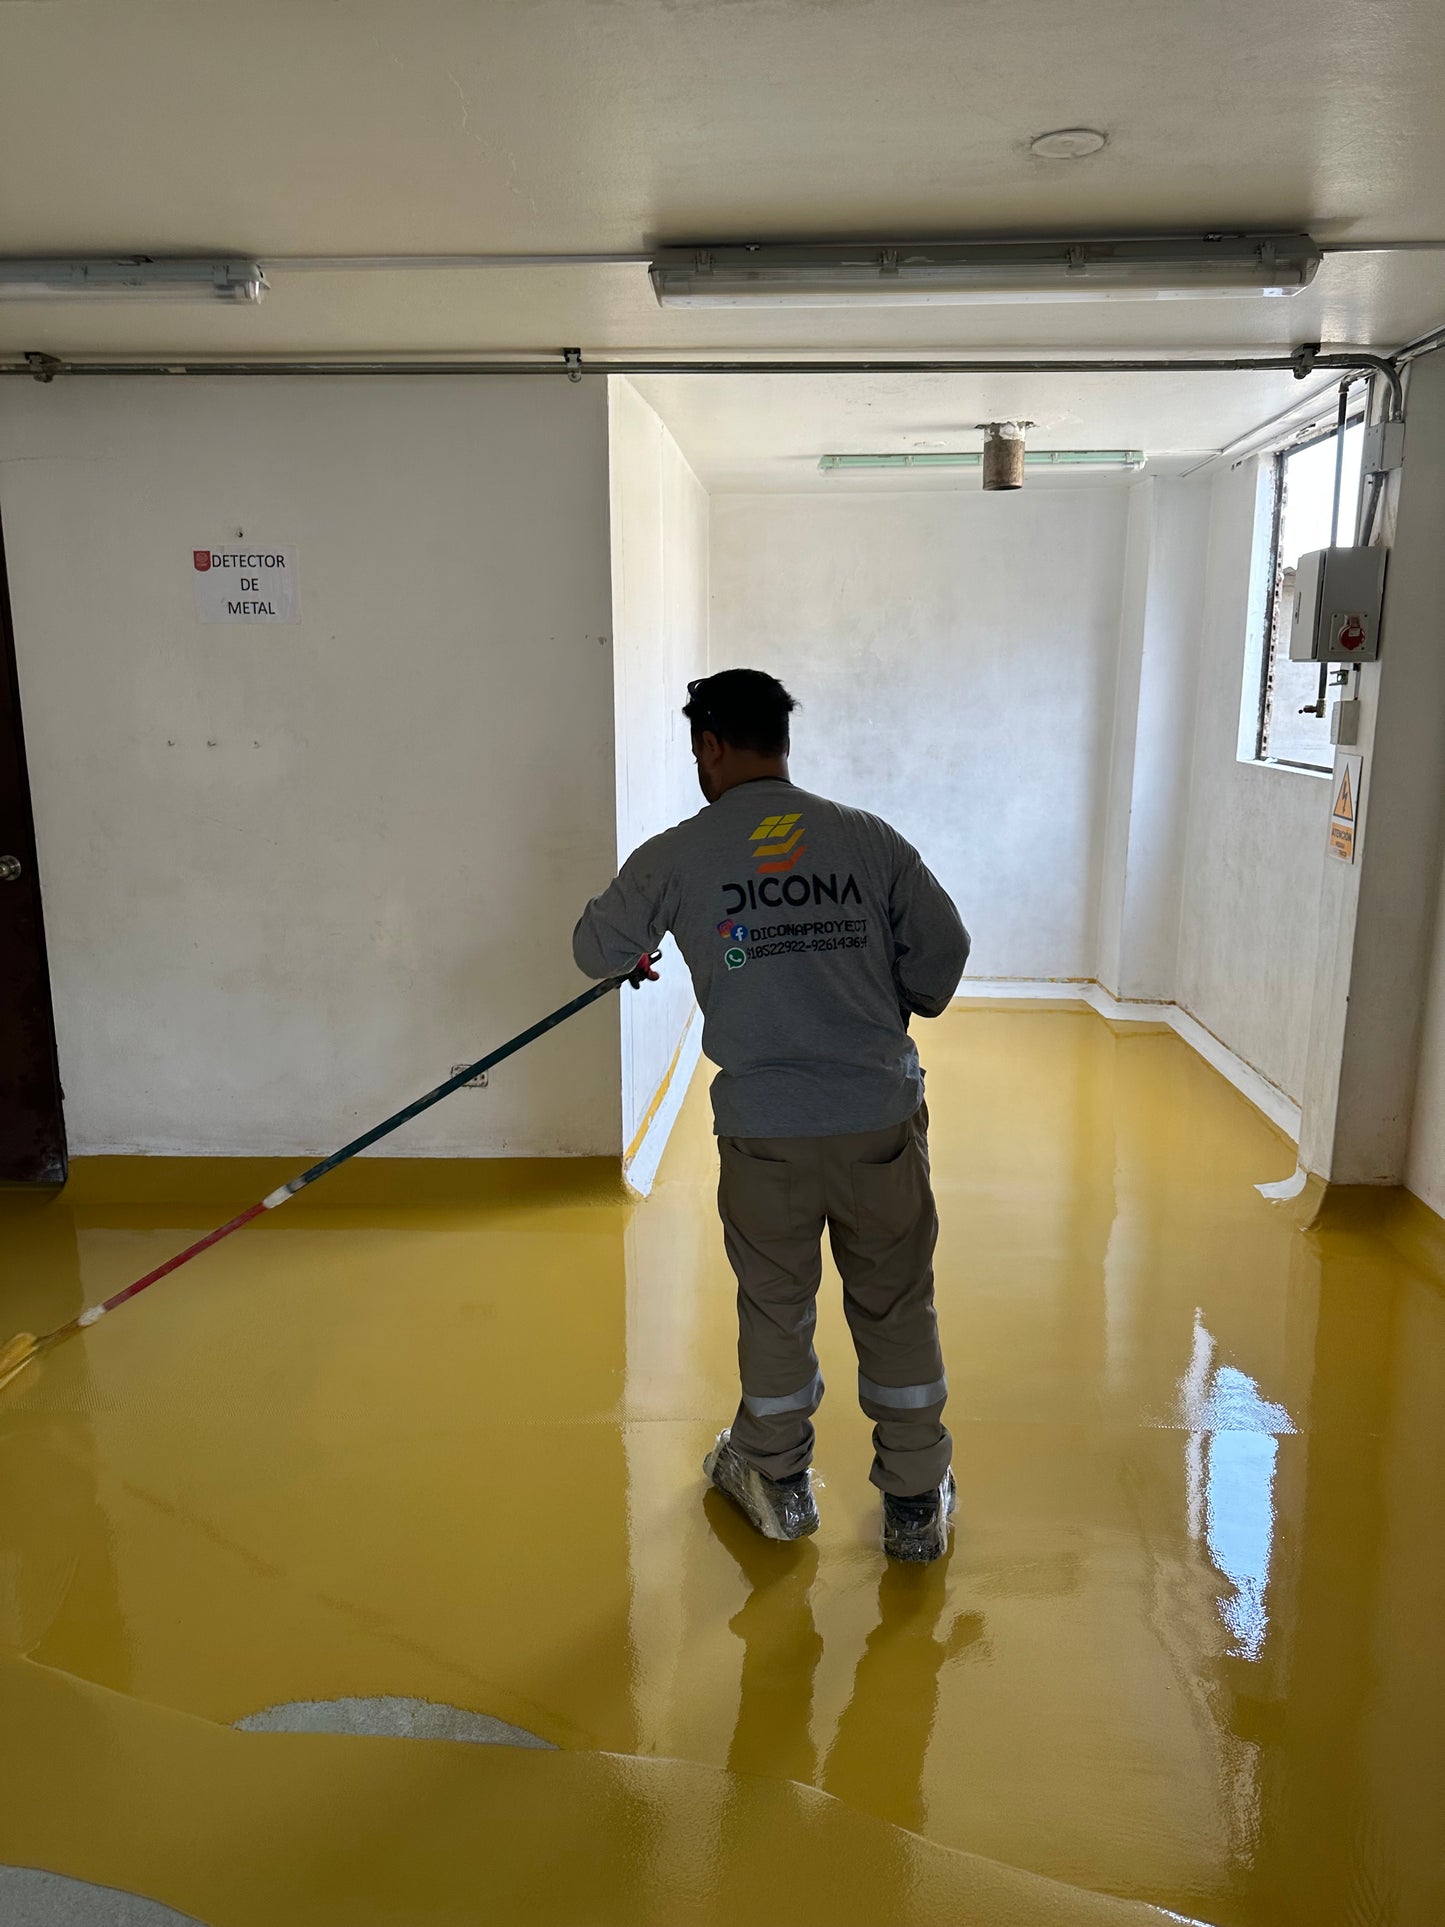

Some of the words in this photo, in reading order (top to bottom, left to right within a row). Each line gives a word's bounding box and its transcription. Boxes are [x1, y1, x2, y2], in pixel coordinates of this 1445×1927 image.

[212, 554, 286, 568] DETECTOR
[240, 578, 259, 591] DE
[228, 601, 275, 615] METAL
[721, 873, 862, 915] DICONA
